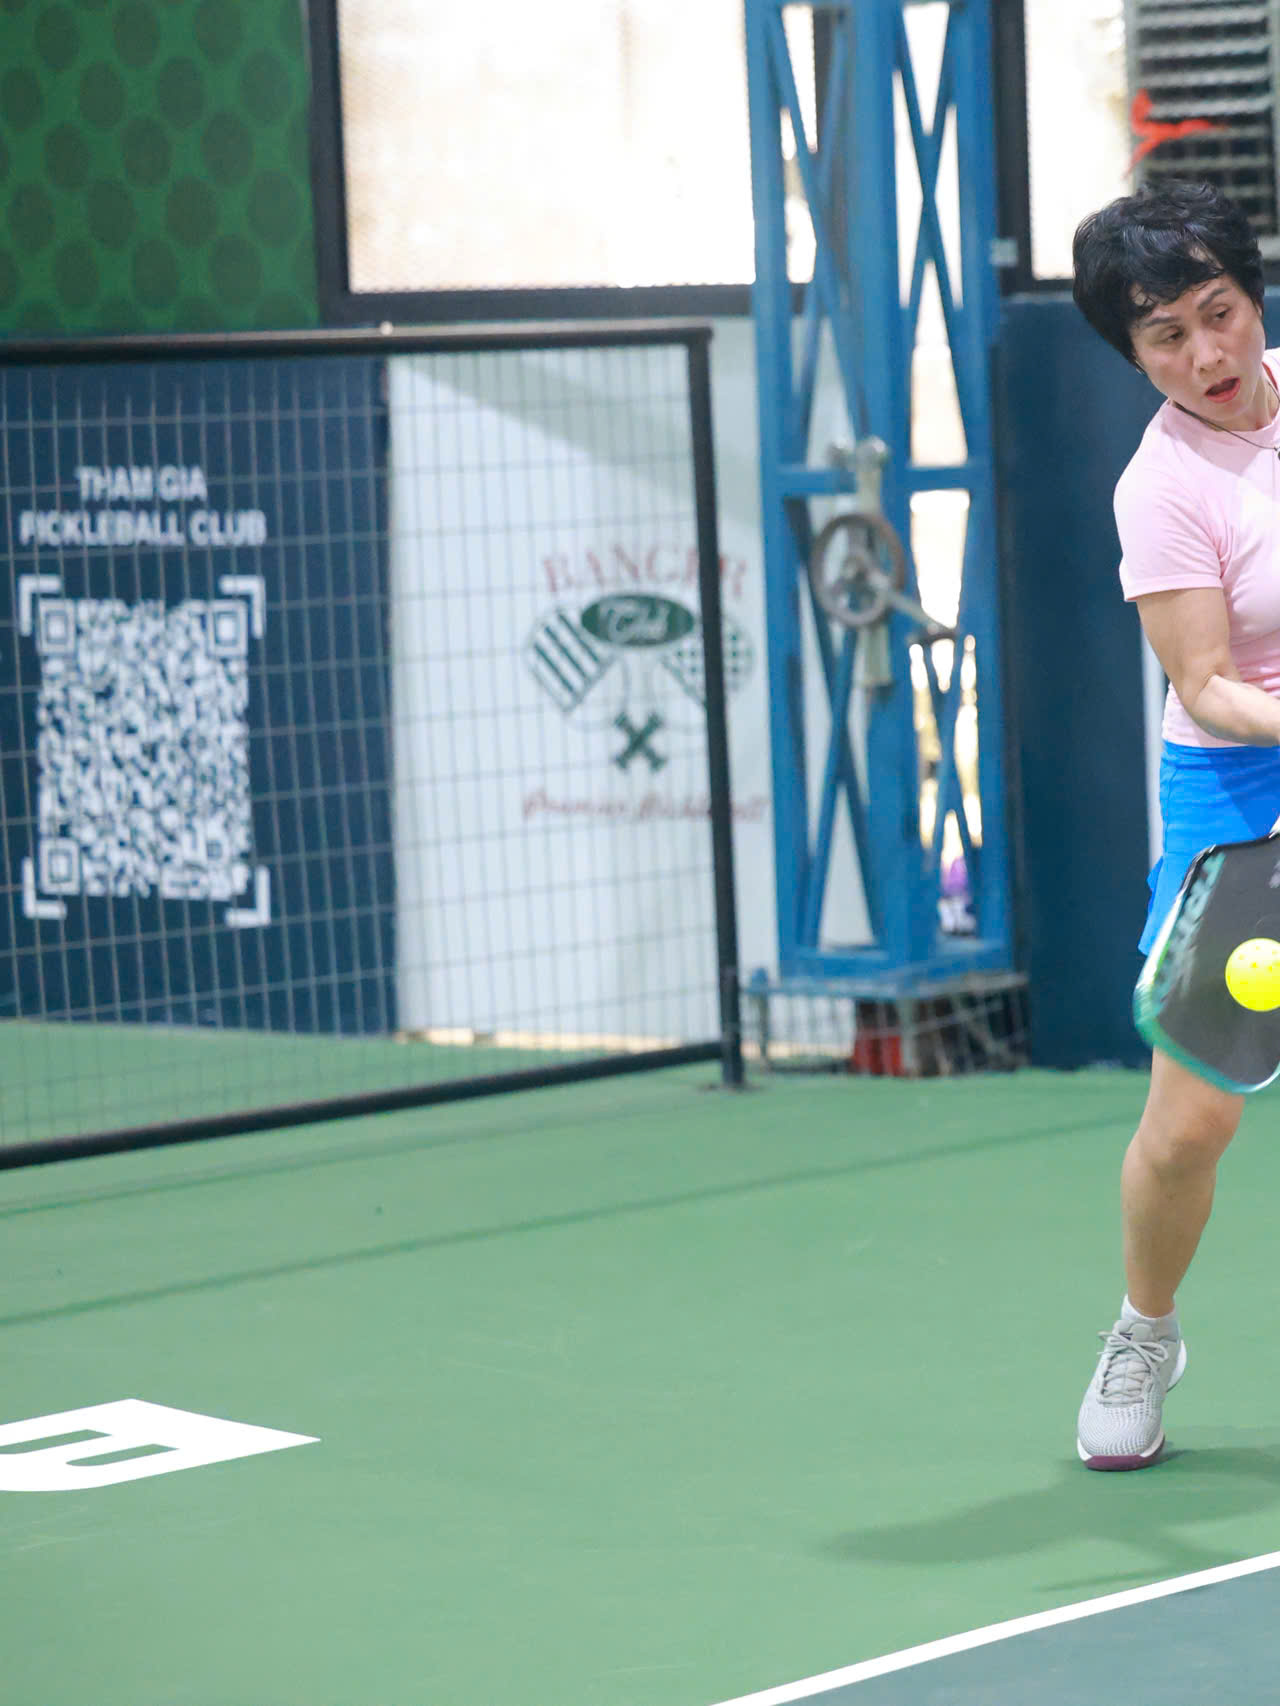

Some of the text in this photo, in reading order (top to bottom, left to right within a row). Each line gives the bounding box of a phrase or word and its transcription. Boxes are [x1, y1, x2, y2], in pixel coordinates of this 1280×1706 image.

[75, 465, 208, 502] THAM GIA
[19, 509, 267, 546] PICKLEBALL CLUB
